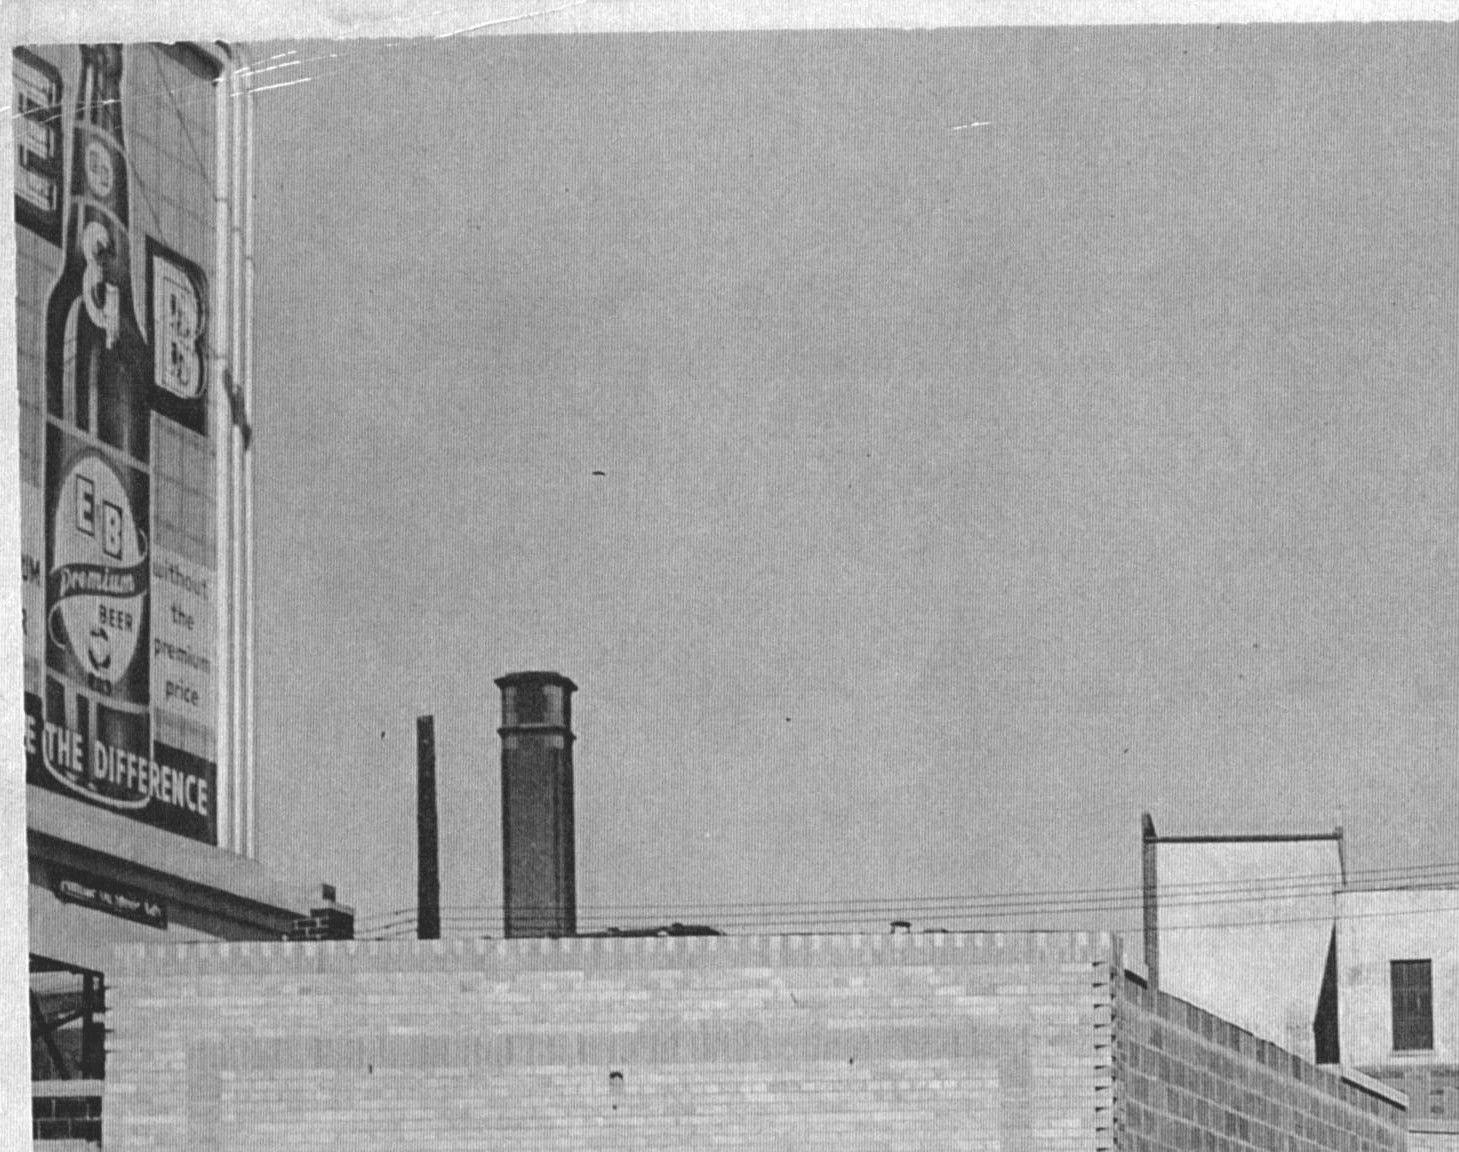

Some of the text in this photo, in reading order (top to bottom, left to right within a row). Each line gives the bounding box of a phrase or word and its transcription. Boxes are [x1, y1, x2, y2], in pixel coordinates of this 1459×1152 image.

[152, 254, 207, 400] B
[153, 562, 209, 600] without
[100, 604, 133, 633] BEER
[170, 602, 195, 631] the
[154, 637, 211, 674] premium
[166, 679, 199, 707] price
[46, 721, 84, 773] THE
[94, 738, 208, 817] DIFFERENCE
